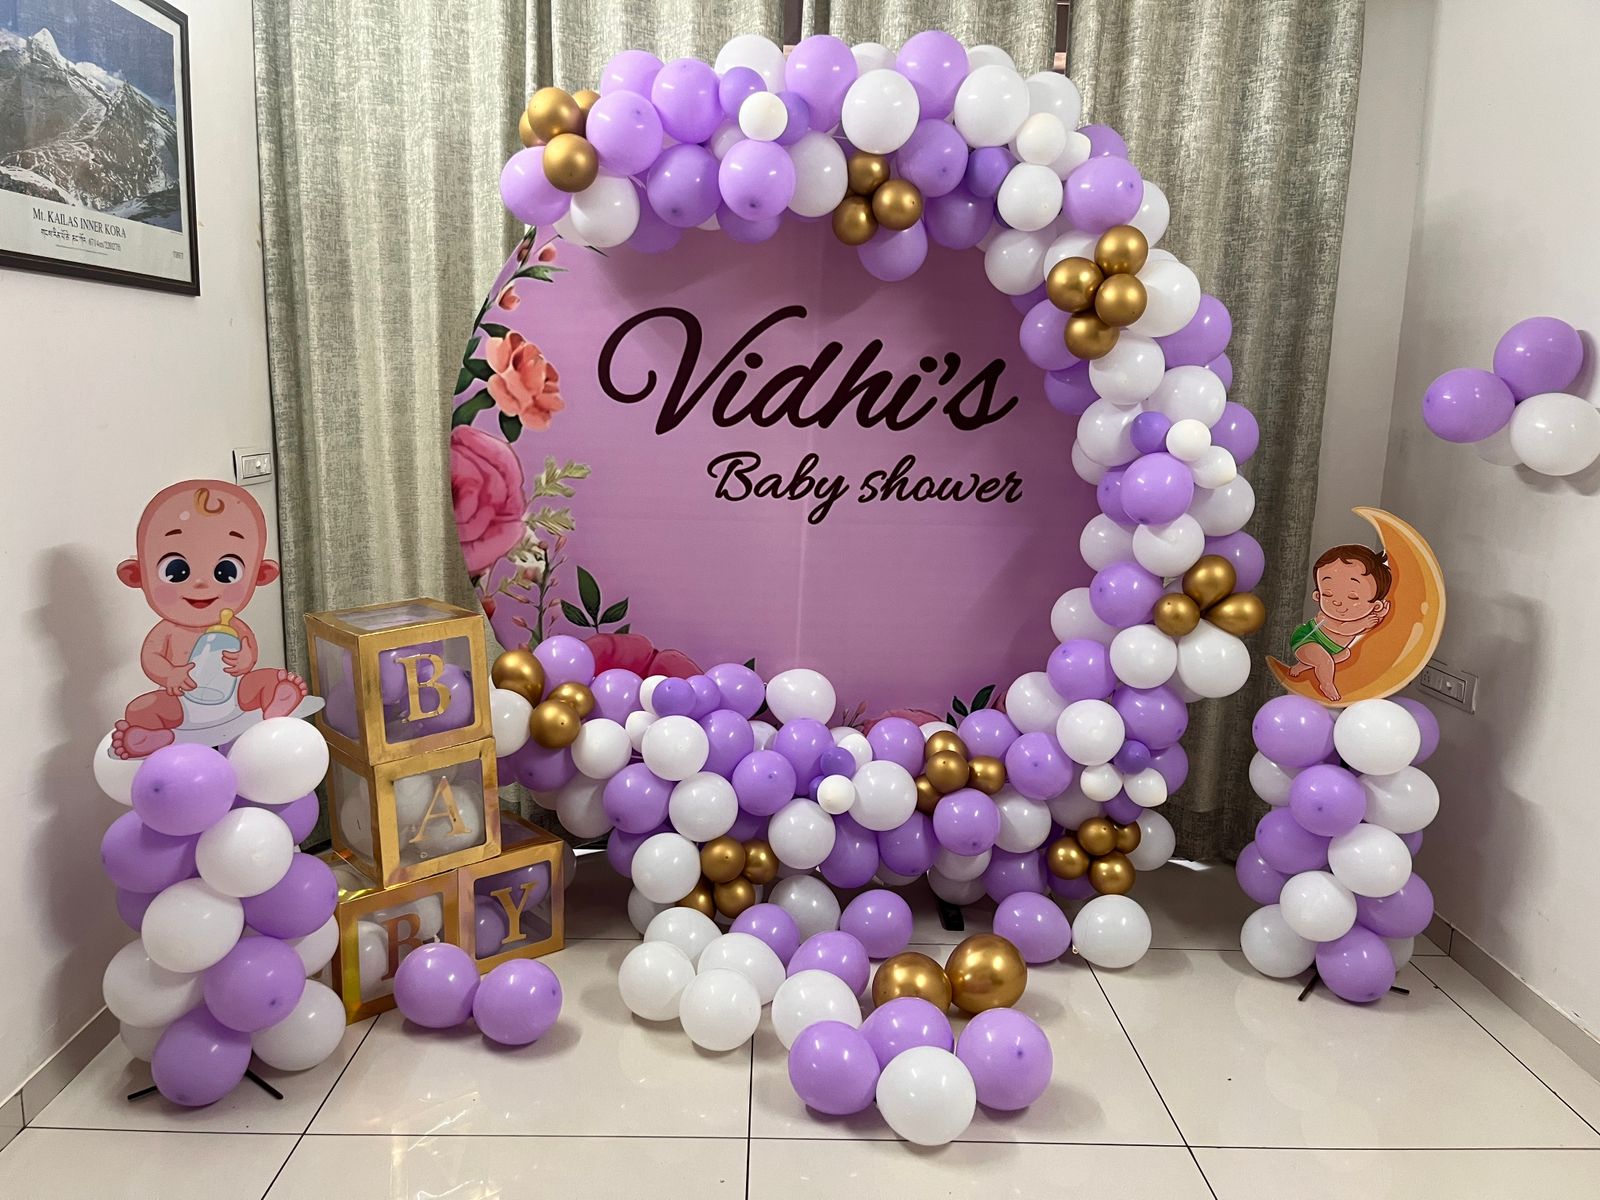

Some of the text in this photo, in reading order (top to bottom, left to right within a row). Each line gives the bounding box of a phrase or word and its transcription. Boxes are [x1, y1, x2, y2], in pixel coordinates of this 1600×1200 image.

[32, 207, 46, 222] Mt.
[47, 211, 79, 228] KAILAS
[80, 217, 103, 232] INNER
[104, 222, 127, 239] KORA
[598, 305, 1019, 435] Vidhi's
[706, 451, 1023, 524] Baby shower
[394, 653, 451, 724] B
[409, 775, 473, 845] A
[490, 881, 539, 946] Y
